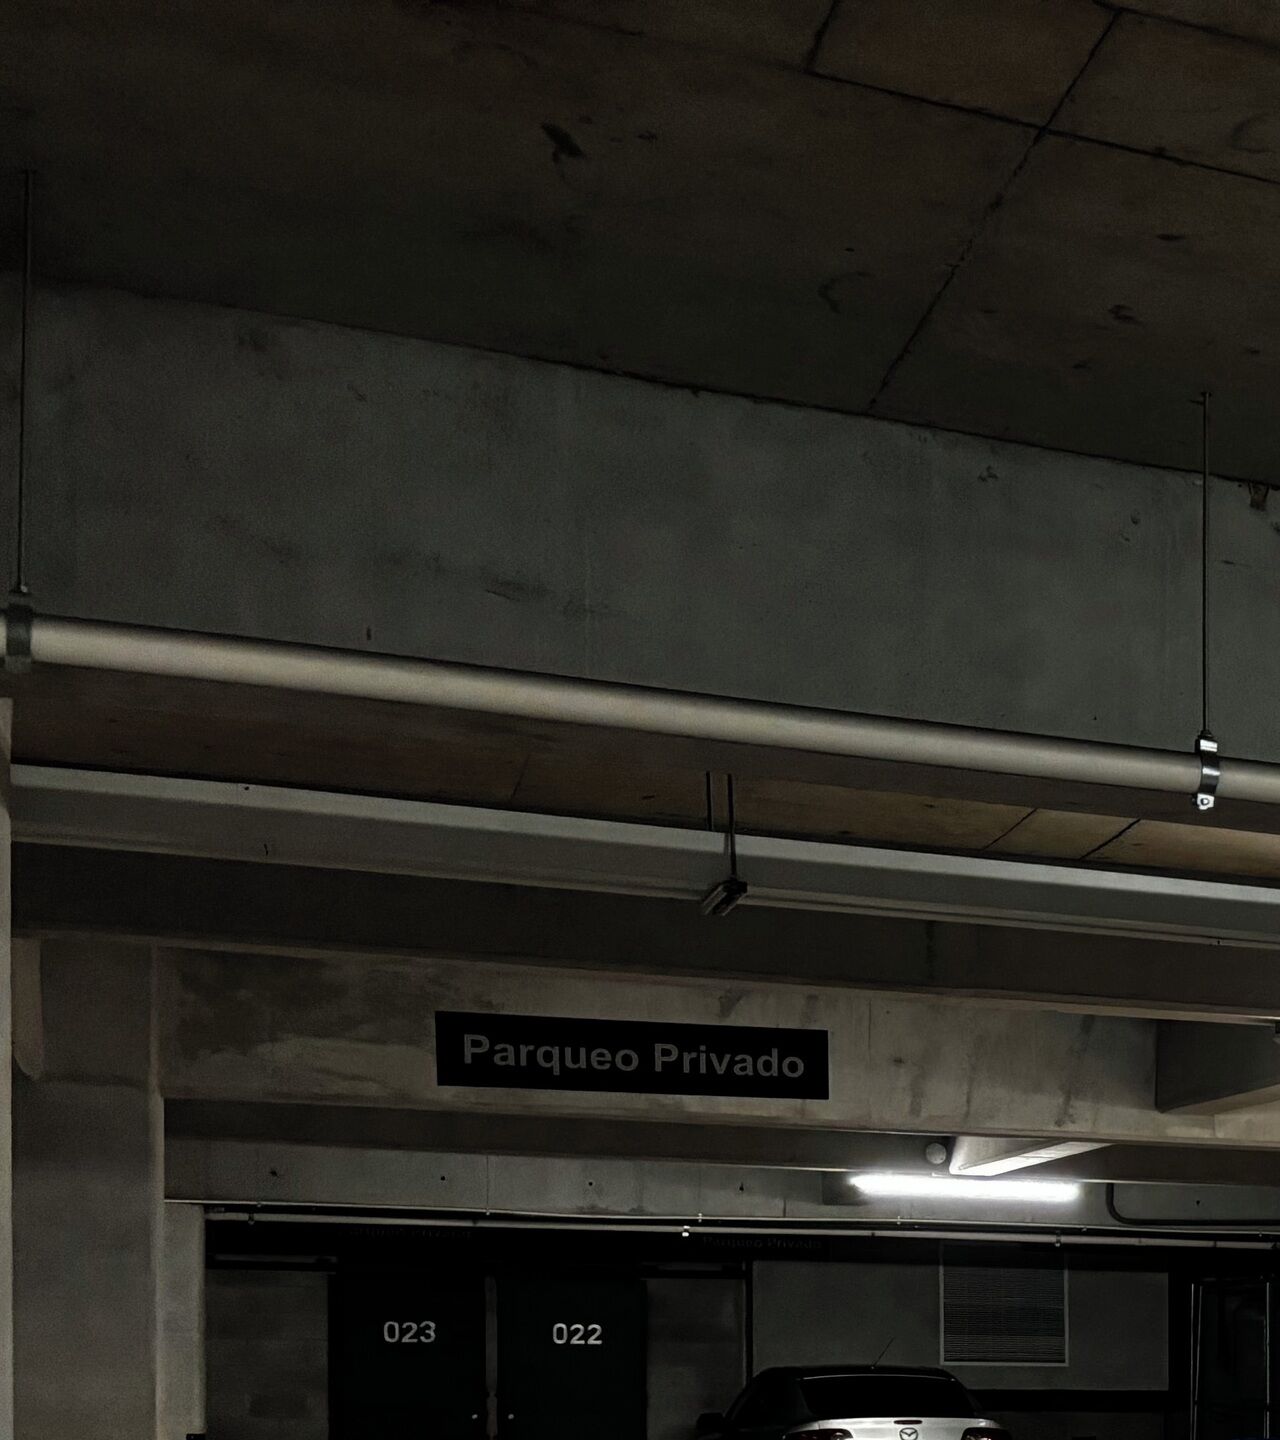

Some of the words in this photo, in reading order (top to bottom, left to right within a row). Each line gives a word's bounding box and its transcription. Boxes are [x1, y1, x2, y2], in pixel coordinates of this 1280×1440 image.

[462, 1033, 641, 1076] Parqueo
[653, 1043, 806, 1079] Privado
[383, 1320, 436, 1343] 023
[552, 1322, 603, 1345] 022
